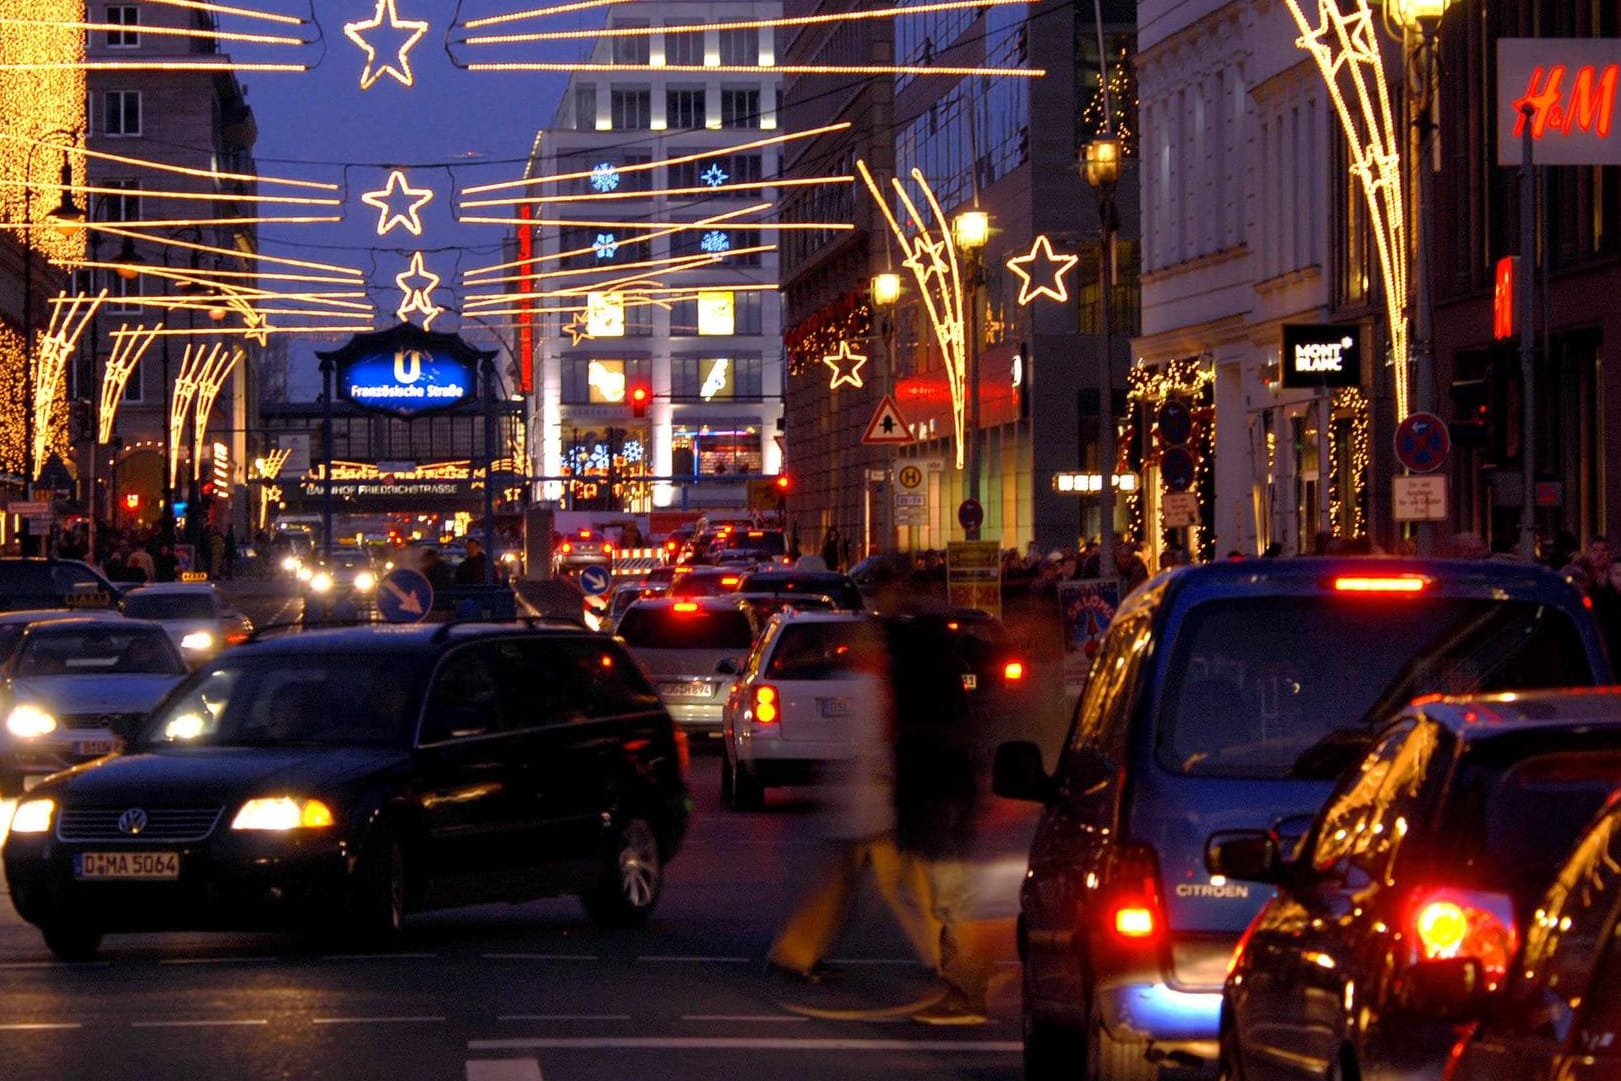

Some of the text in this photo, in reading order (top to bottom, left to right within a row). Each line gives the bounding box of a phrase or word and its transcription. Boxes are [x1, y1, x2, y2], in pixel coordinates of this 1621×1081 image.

[1511, 63, 1620, 140] H&M
[1295, 343, 1342, 358] MONT
[393, 351, 421, 384] U
[1295, 357, 1343, 372] BLANC
[351, 383, 464, 398] Französische Straße
